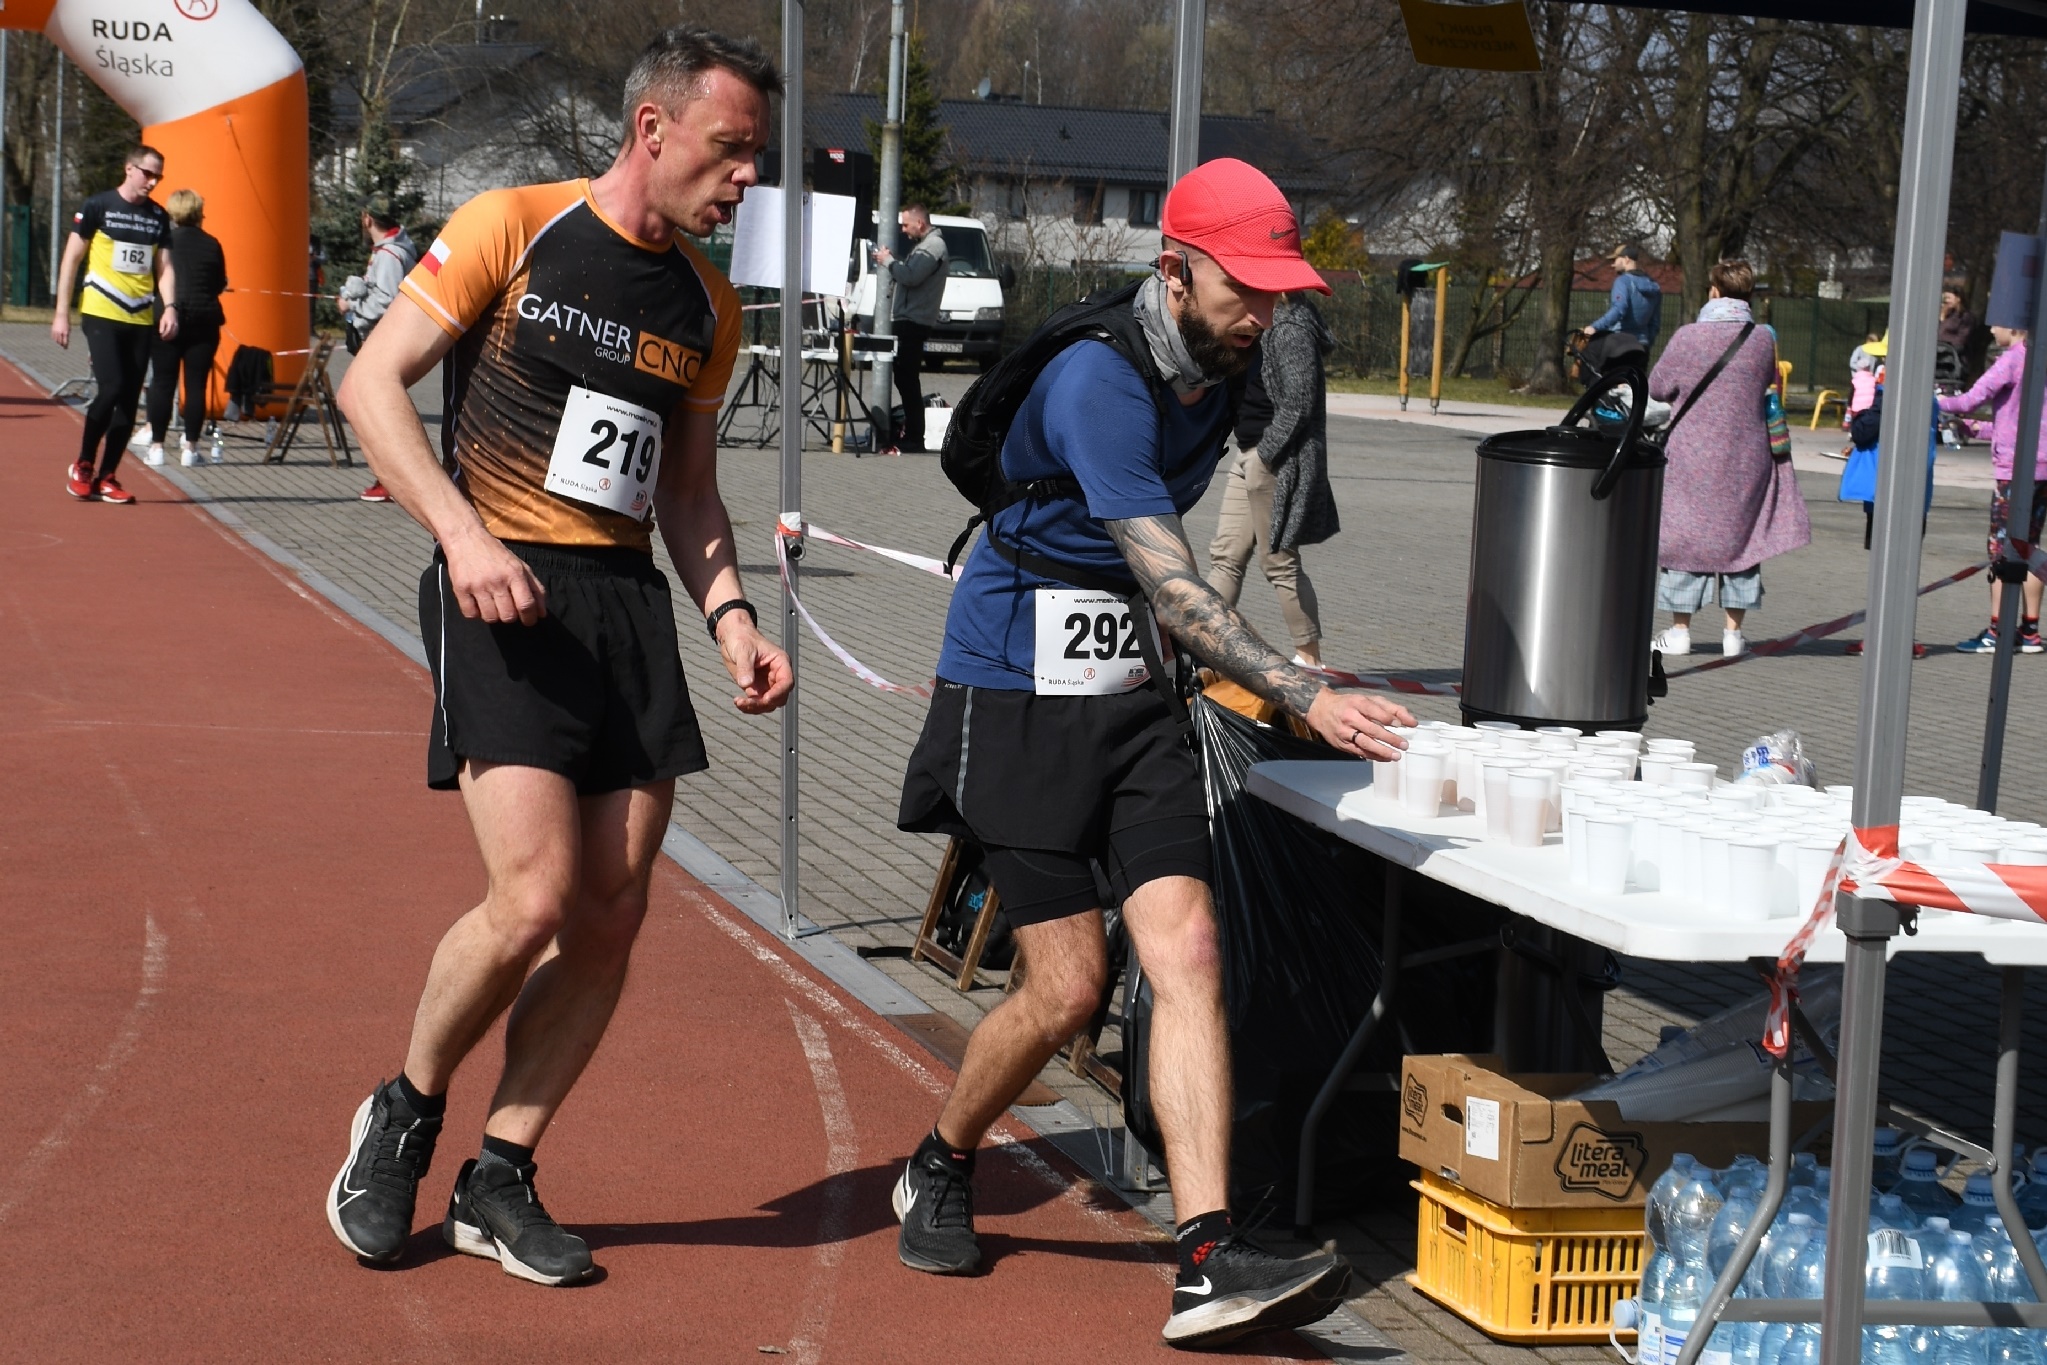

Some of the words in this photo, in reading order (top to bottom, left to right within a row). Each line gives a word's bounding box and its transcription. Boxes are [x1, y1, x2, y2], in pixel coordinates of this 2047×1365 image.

[92, 19, 173, 42] RUDA
[95, 45, 174, 77] Śląska
[122, 250, 145, 264] 162
[516, 293, 631, 353] GATNER
[595, 346, 631, 365] GROUP
[582, 419, 656, 484] 219
[560, 477, 580, 489] RUDA
[1063, 612, 1142, 661] 292
[1570, 1143, 1624, 1167] litera
[1580, 1158, 1631, 1178] meat
